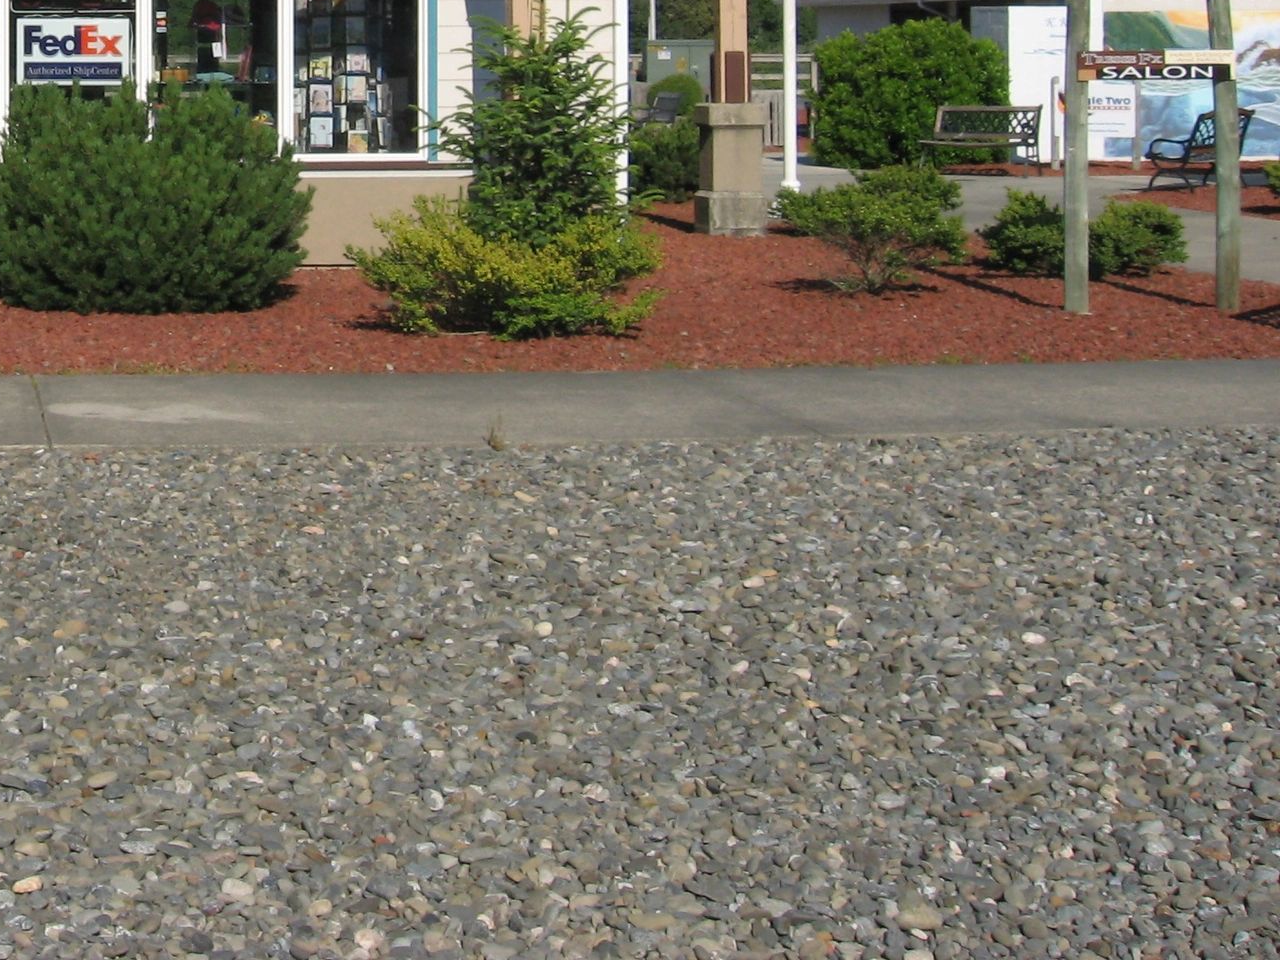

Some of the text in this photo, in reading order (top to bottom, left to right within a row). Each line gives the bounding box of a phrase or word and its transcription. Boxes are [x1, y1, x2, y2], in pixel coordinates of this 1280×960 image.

[23, 25, 124, 57] FedEx
[28, 66, 119, 77] Authorized ShipCenter
[1102, 66, 1213, 79] SALON
